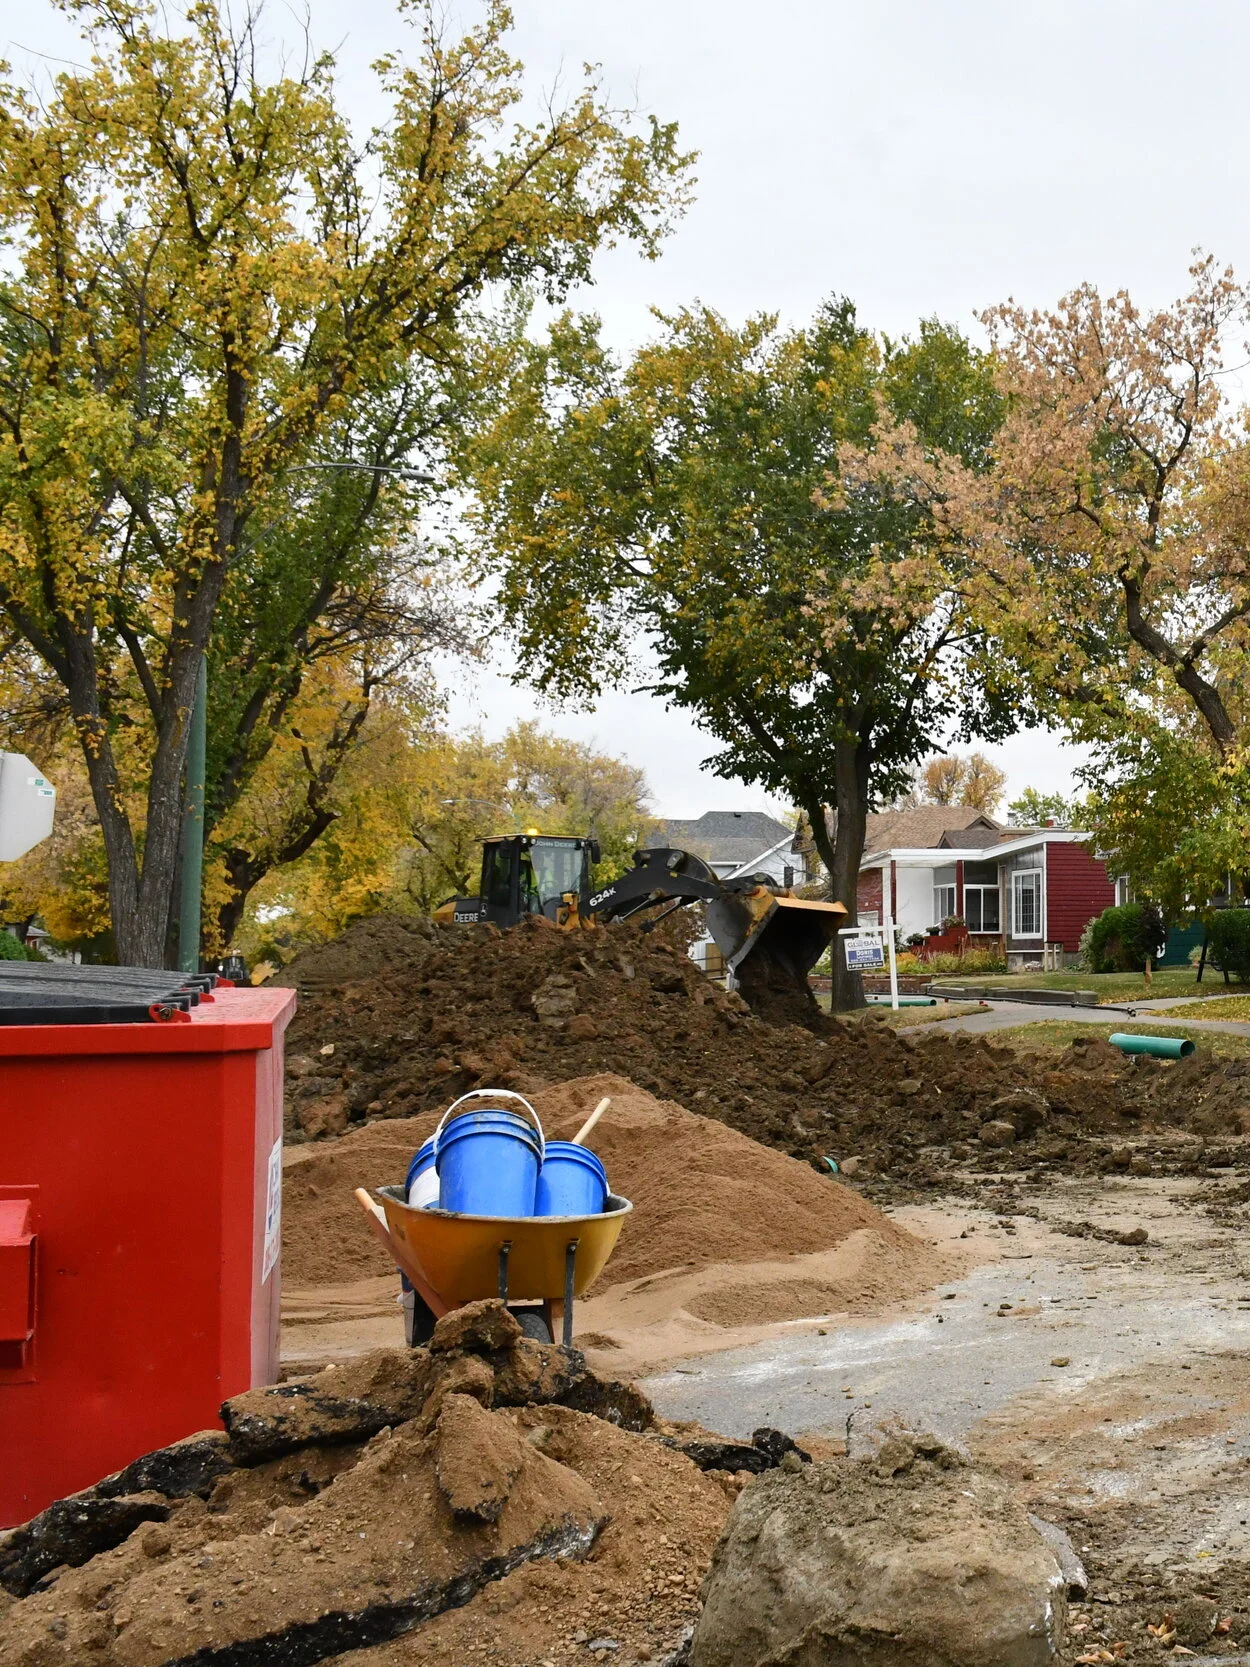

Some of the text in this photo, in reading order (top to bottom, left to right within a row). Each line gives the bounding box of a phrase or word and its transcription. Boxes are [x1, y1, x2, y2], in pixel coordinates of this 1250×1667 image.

[535, 840, 553, 848] JOHN
[589, 886, 617, 907] 624K
[453, 911, 479, 923] DEERE
